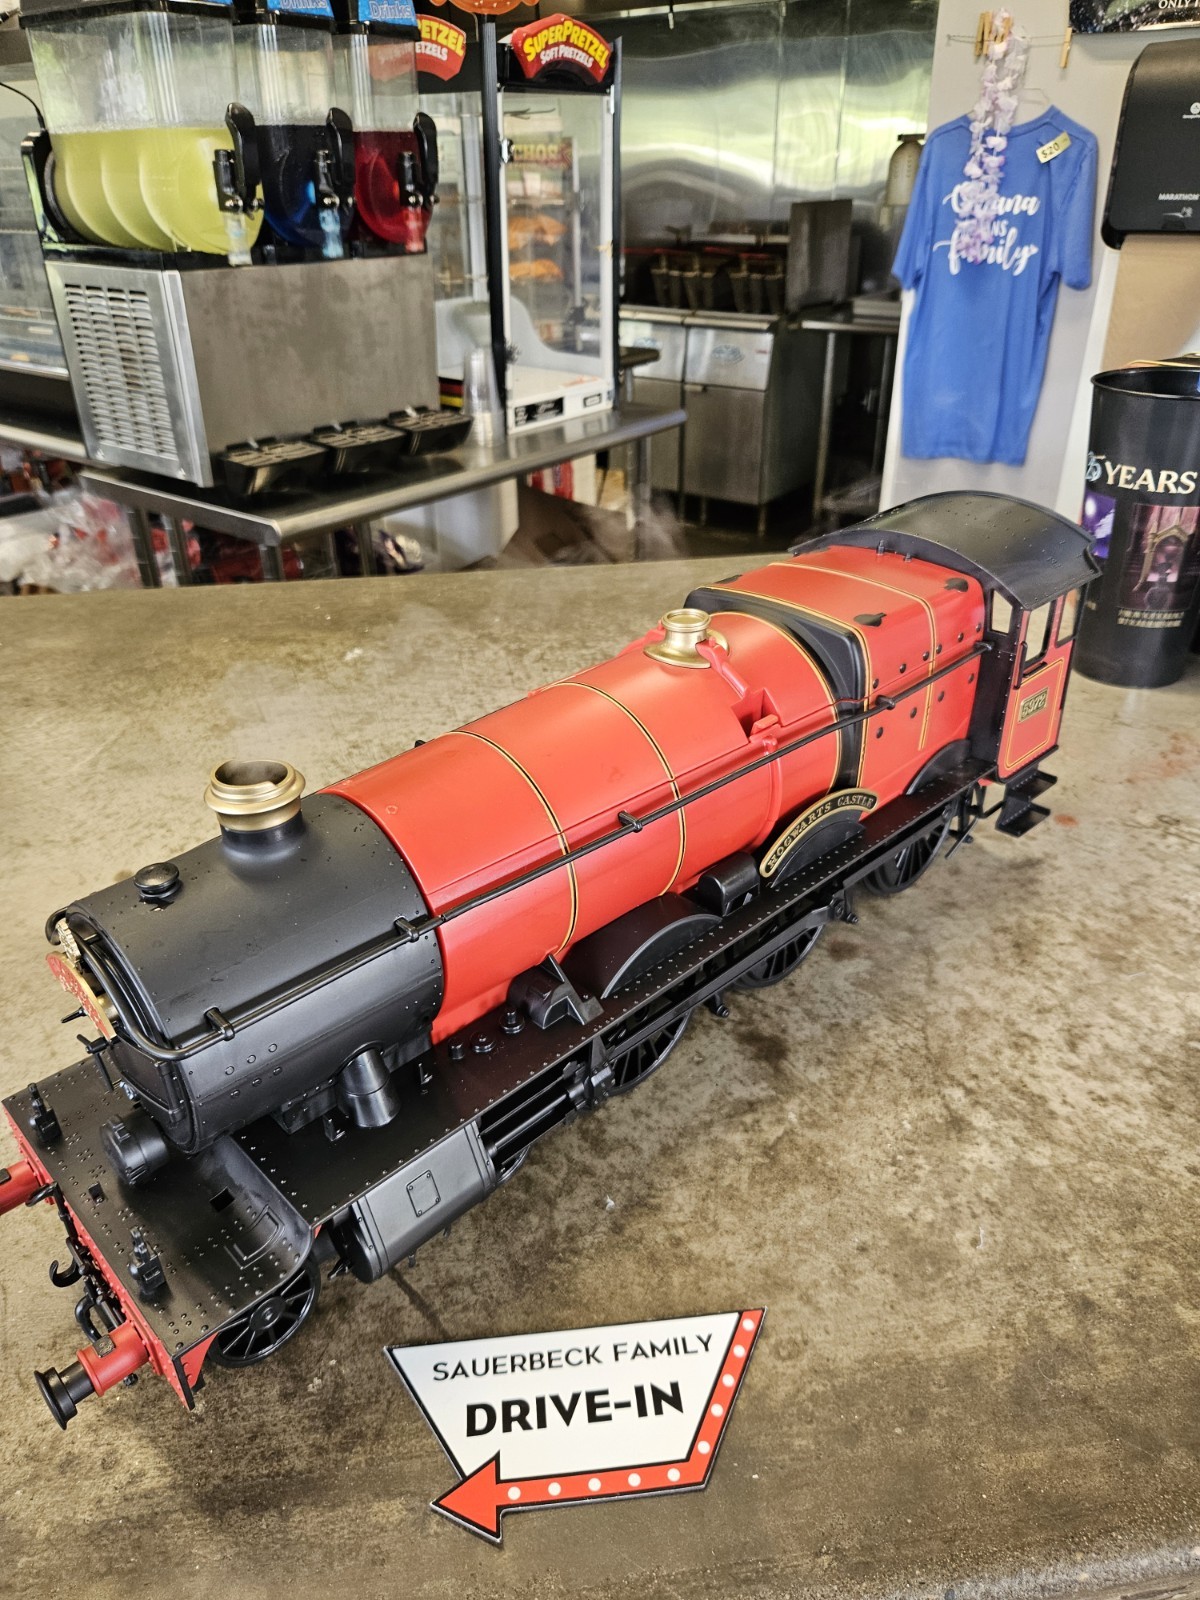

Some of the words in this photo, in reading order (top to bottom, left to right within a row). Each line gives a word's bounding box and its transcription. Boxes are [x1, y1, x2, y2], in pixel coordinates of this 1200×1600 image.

[369, 1, 412, 18] Drinks
[523, 20, 609, 69] SUPERPRETZEL
[540, 45, 559, 65] SOFT
[559, 45, 594, 68] PRETZELS
[1104, 461, 1198, 494] YEARS
[767, 802, 832, 869] HOGWARTS
[837, 795, 875, 808] CASTLE
[433, 1345, 603, 1382] SAUERBECK
[613, 1333, 713, 1362] FAMILY
[465, 1381, 685, 1437] DRIVE-IN
